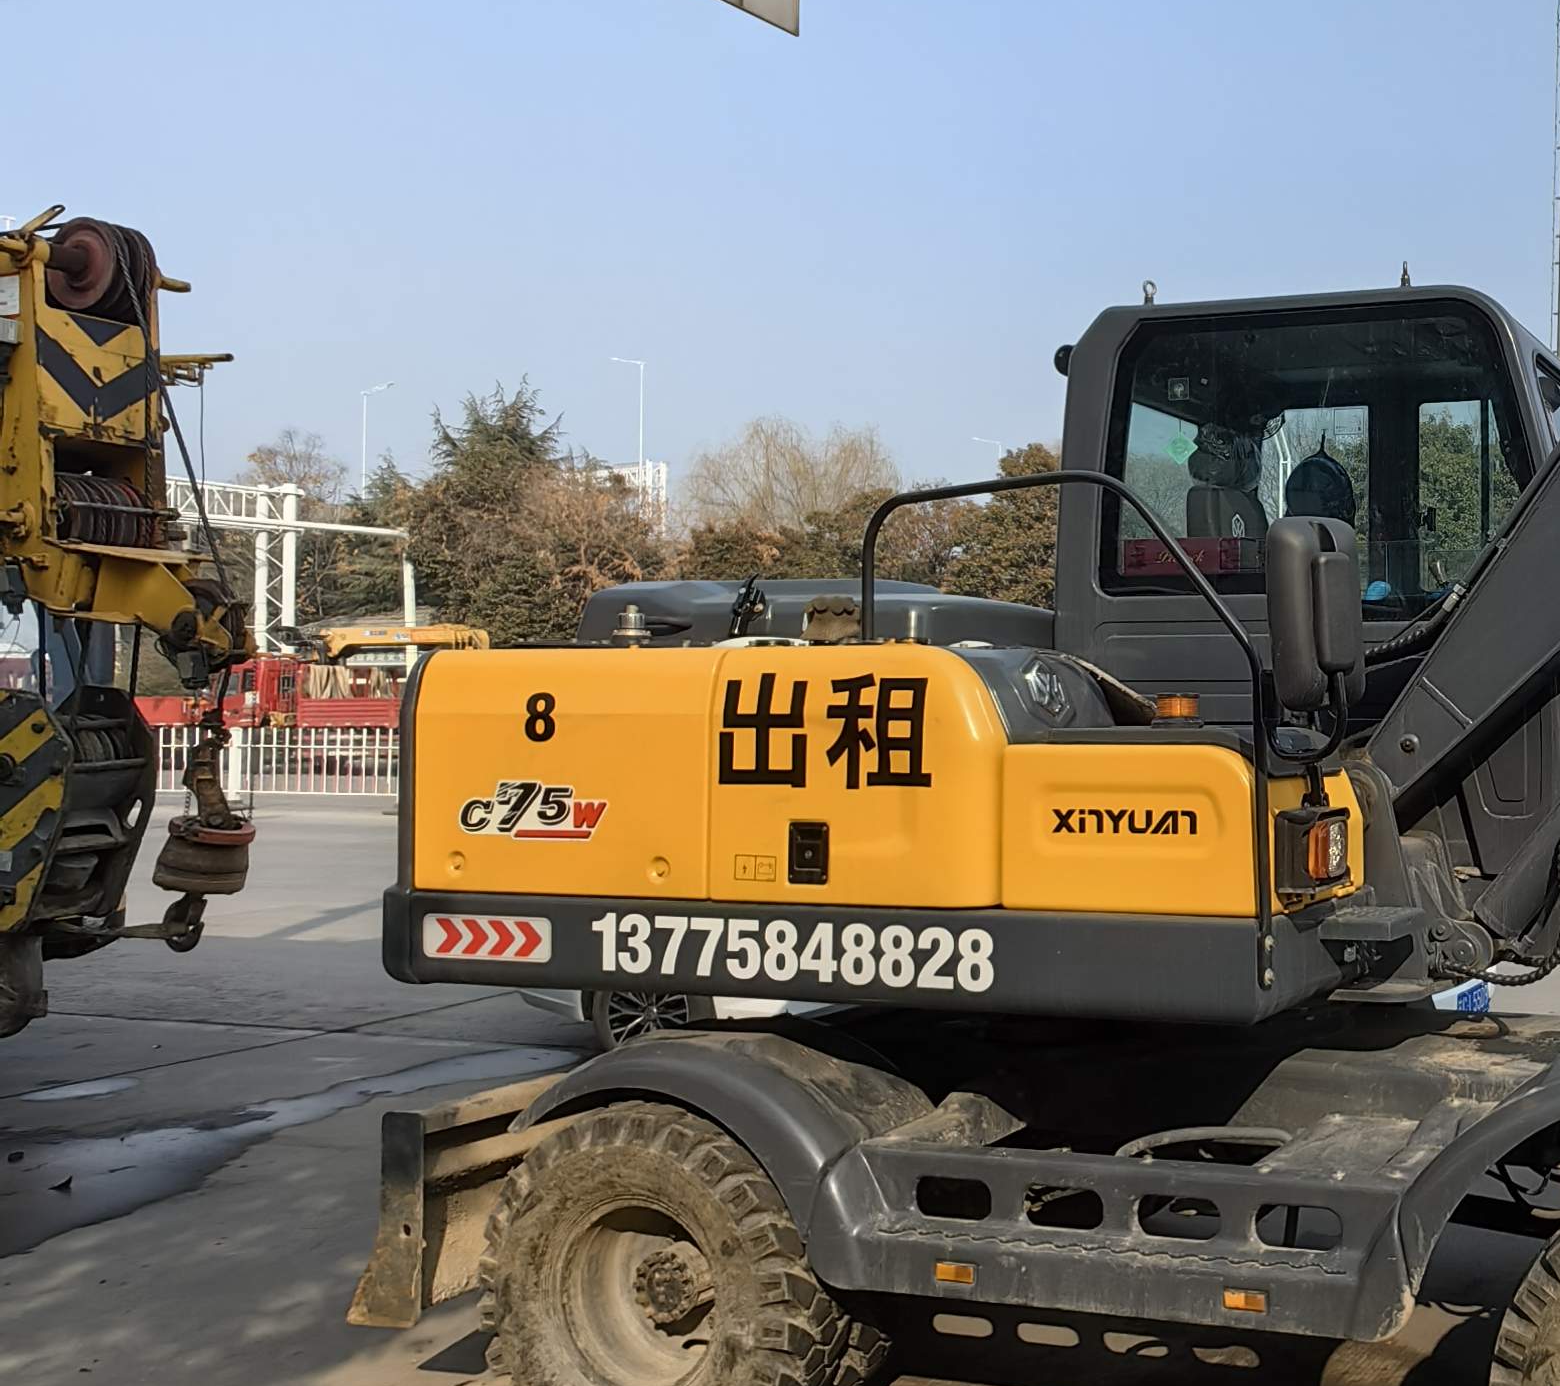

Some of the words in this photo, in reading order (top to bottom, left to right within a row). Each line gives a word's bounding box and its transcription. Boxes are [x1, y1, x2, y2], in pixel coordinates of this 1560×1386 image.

[525, 693, 555, 742] 8
[719, 673, 931, 789] 出租
[592, 913, 994, 992] 13775848828
